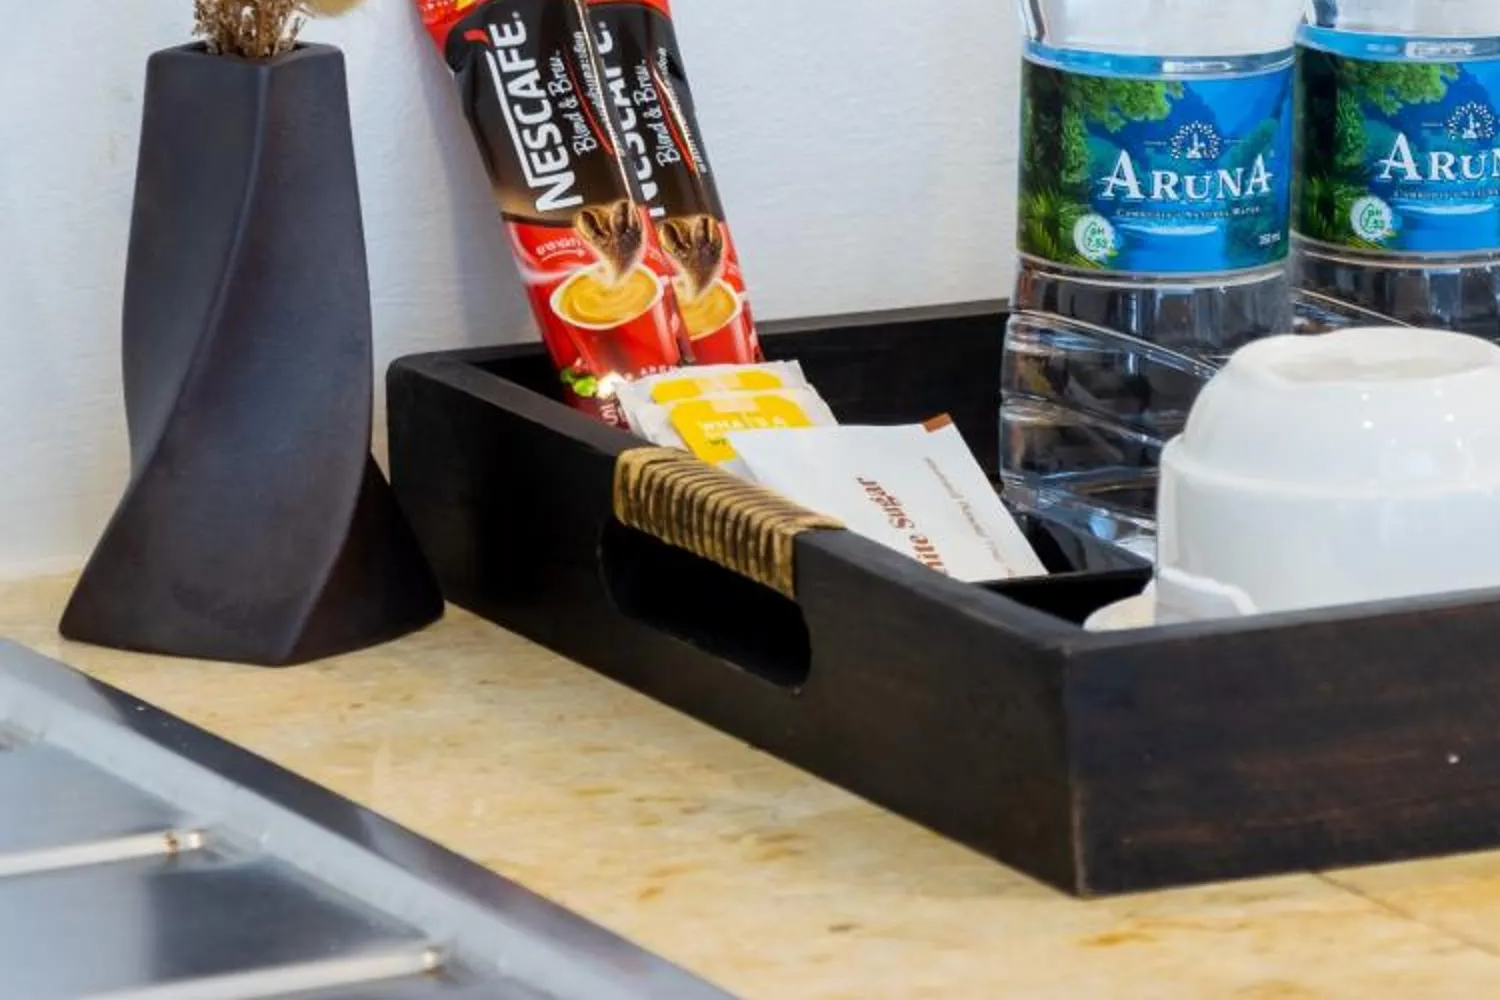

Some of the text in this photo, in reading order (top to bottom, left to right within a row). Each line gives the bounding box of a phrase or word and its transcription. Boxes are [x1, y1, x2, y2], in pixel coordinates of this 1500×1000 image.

[562, 112, 598, 157] Blend
[1100, 149, 1273, 201] ARUNA
[856, 476, 915, 530] Sugar
